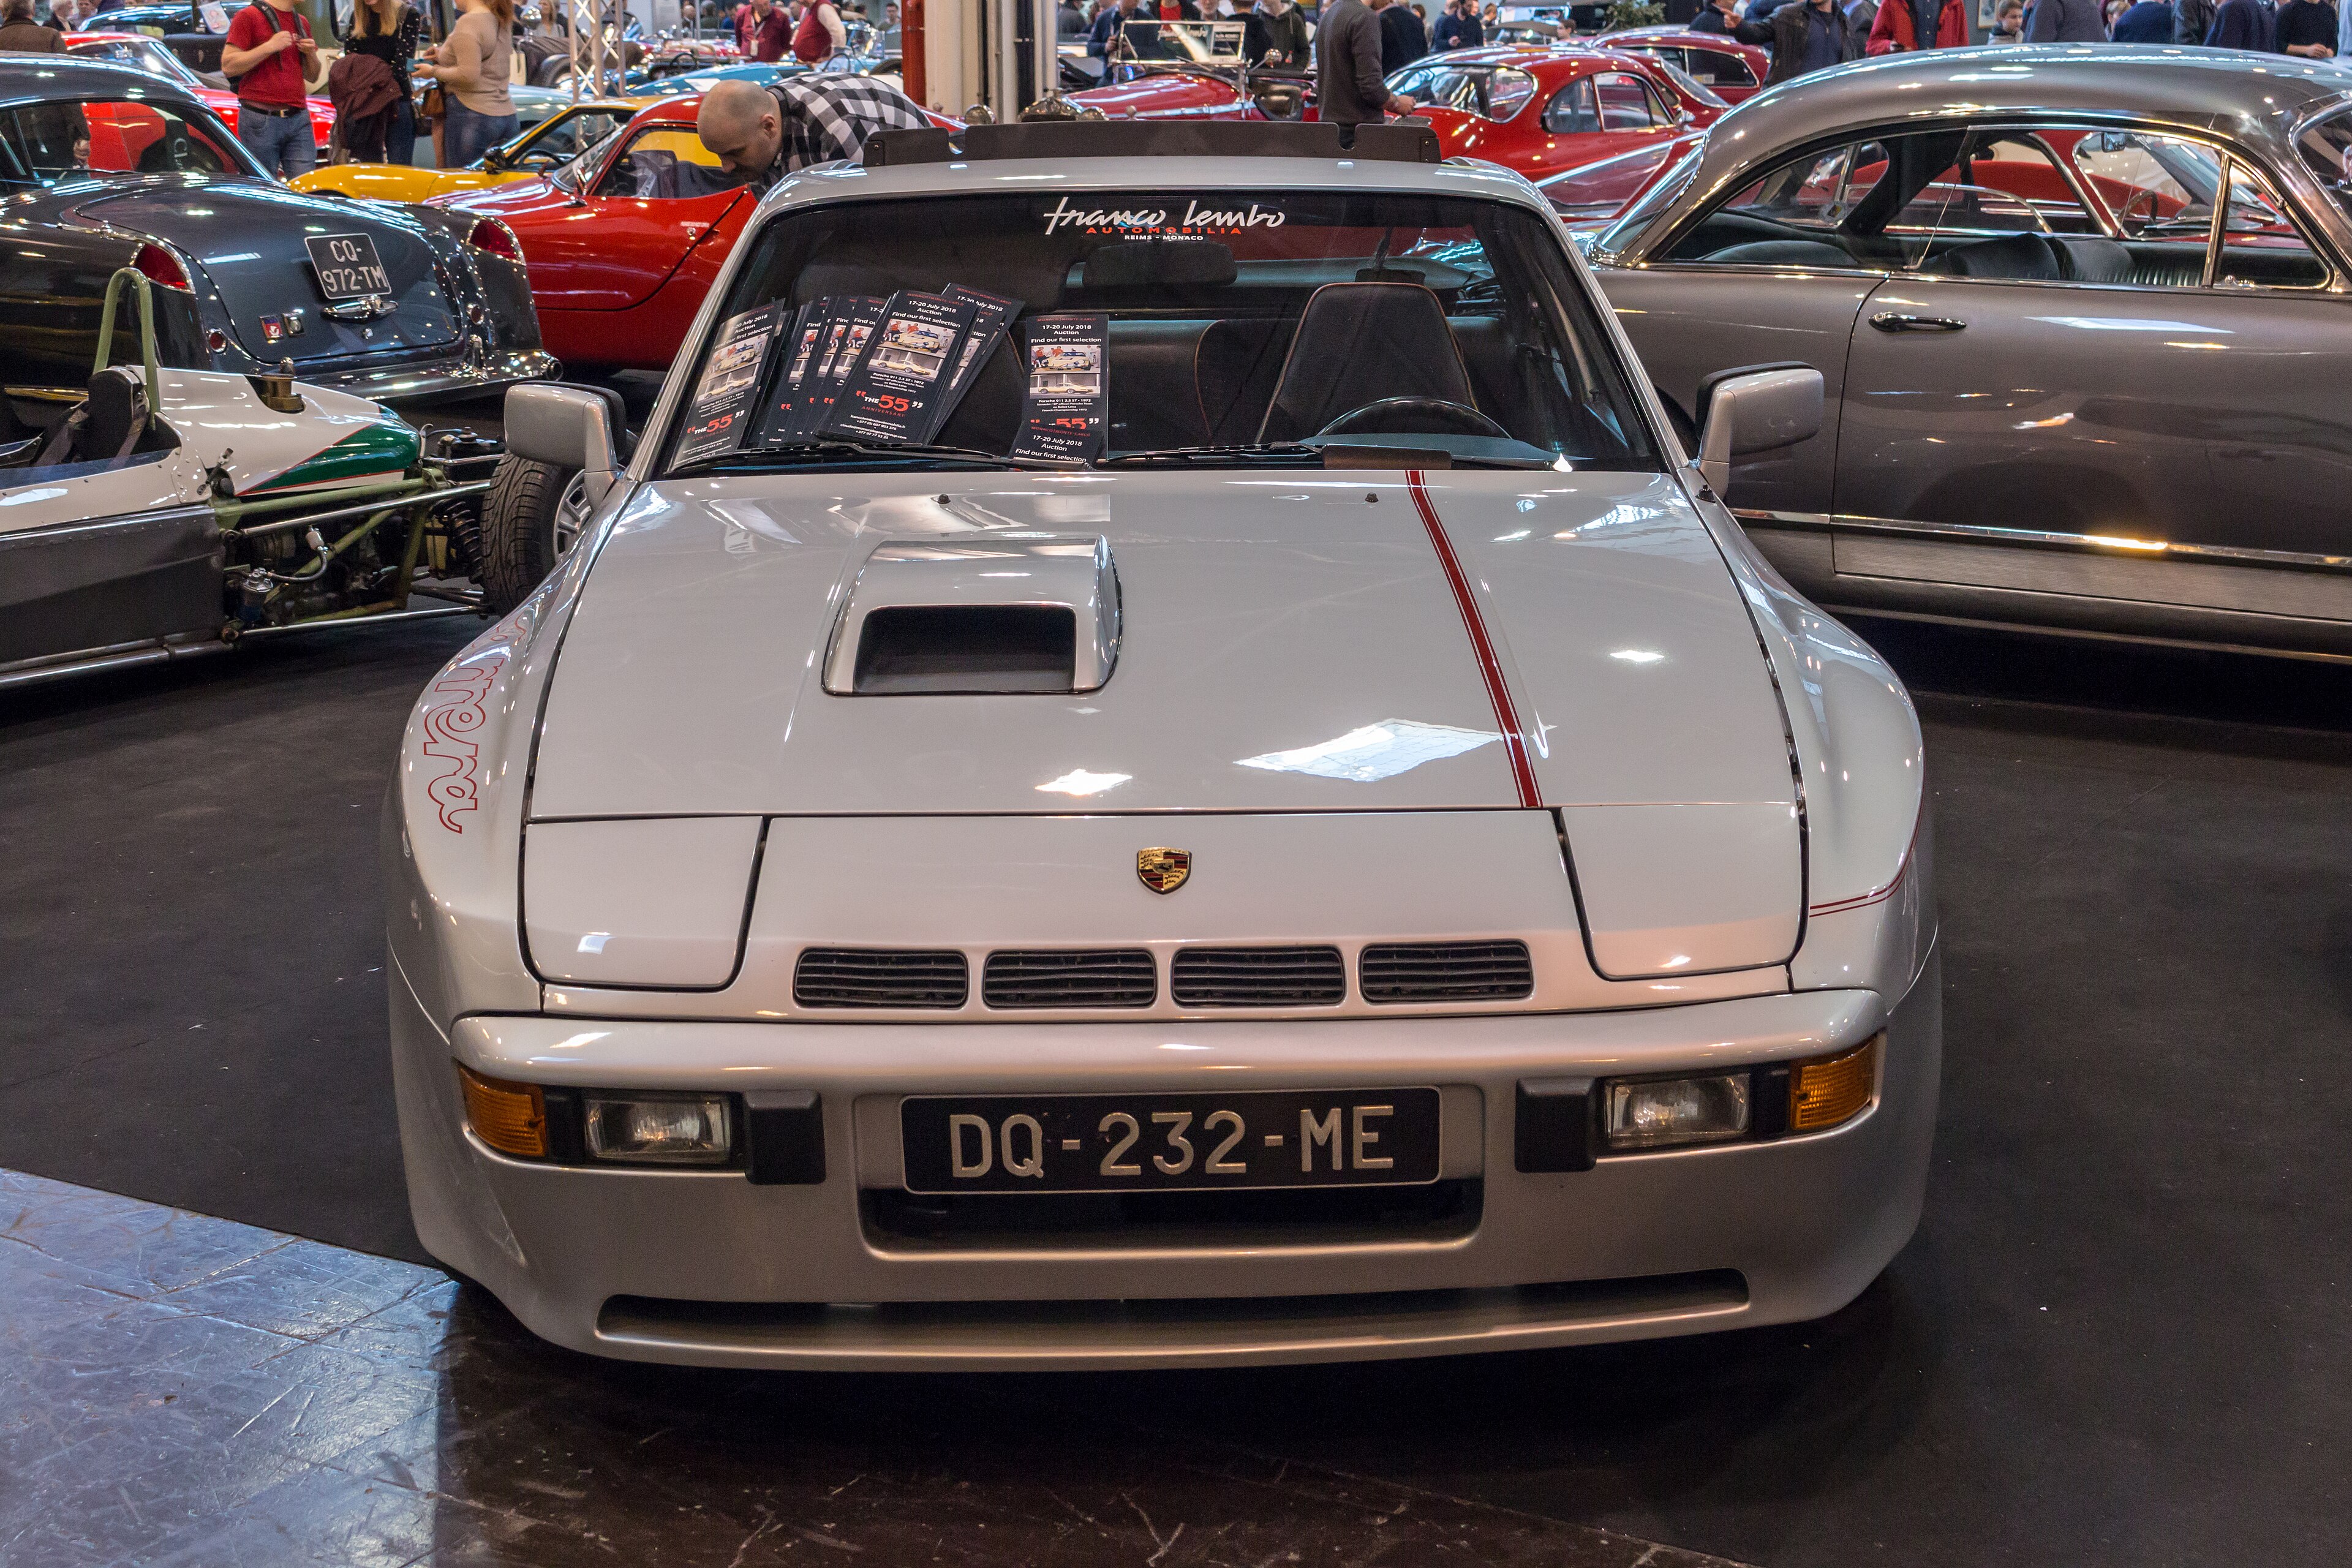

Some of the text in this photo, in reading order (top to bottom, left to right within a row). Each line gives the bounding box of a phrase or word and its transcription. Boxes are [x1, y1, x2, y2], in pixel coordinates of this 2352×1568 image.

[1183, 200, 1286, 228] lembo
[1086, 227, 1242, 235] AUTOMOBILIA
[322, 266, 388, 293] 972-TM
[917, 307, 942, 316] Auction
[753, 314, 768, 322] 2018
[932, 318, 960, 328] selection
[734, 323, 756, 334] Auction
[747, 325, 772, 337] selection
[1041, 443, 1067, 451] Auction
[1057, 454, 1087, 463] selection
